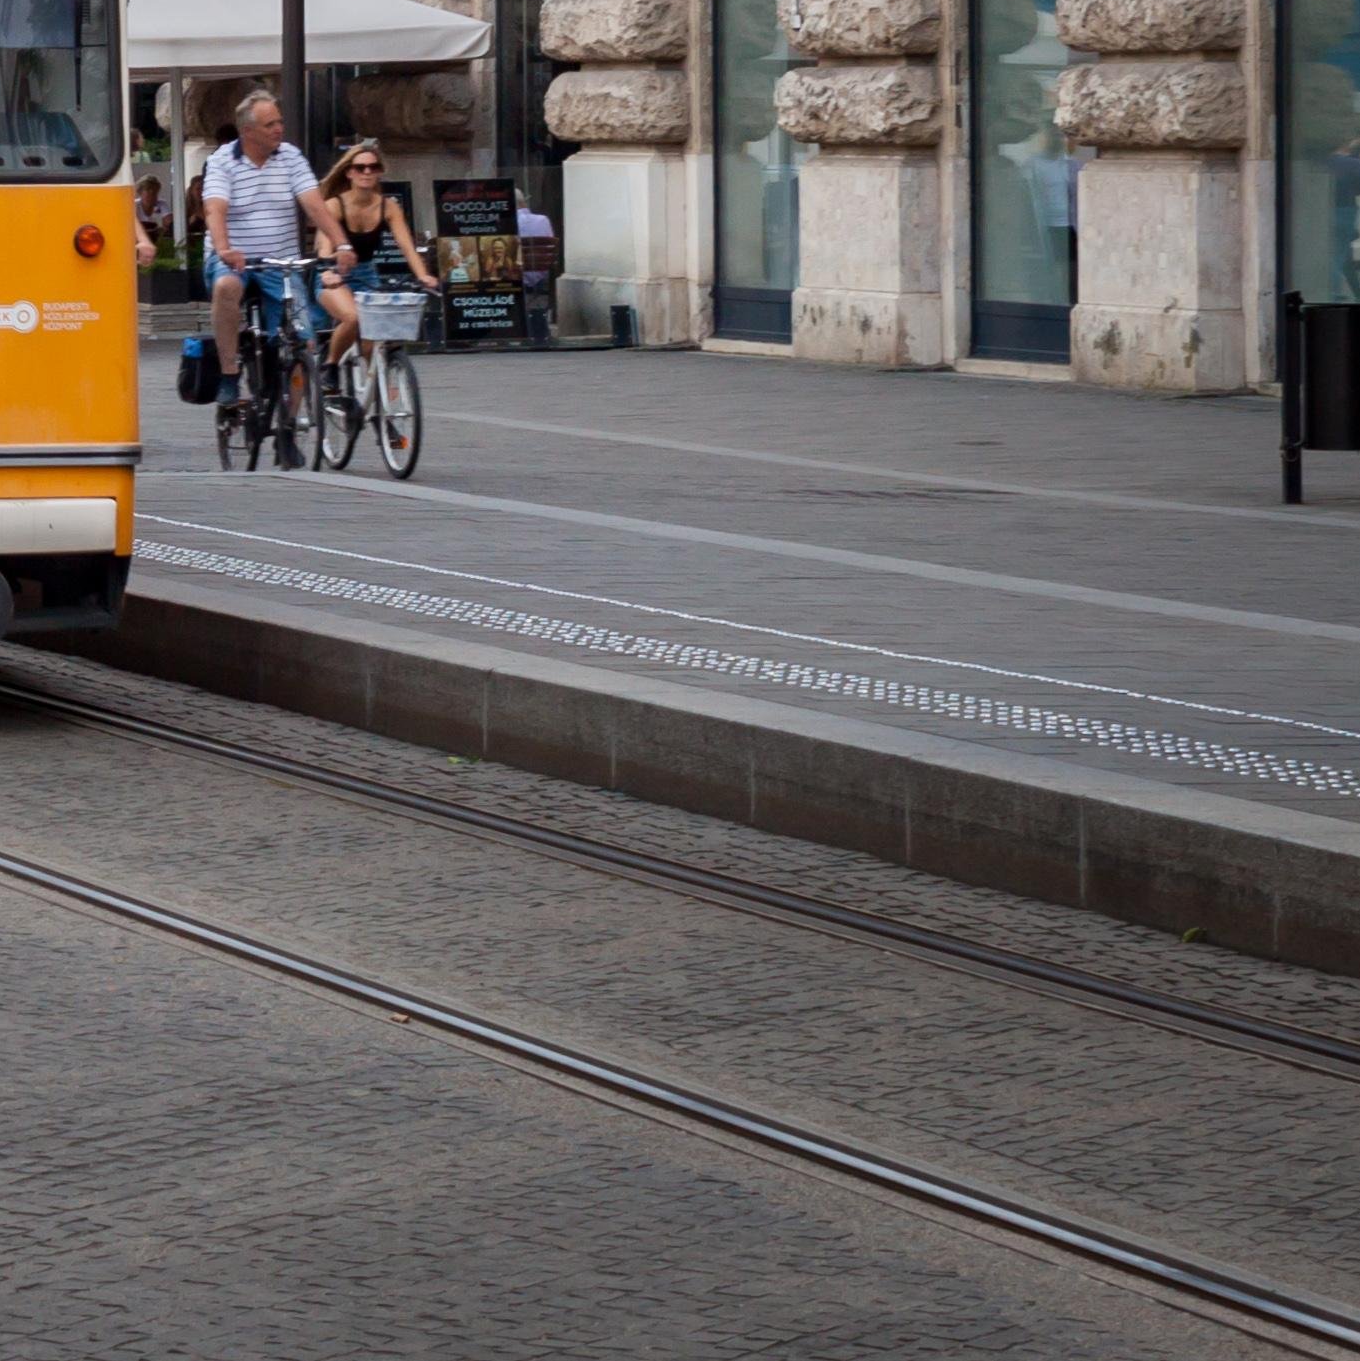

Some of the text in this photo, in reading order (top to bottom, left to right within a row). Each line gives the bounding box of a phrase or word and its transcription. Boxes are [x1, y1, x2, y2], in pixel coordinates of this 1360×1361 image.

[442, 200, 509, 213] CHOCOLATE
[453, 213, 500, 224] MUSEUM
[452, 294, 515, 307] CSOKOLÁDÉ
[462, 307, 508, 318] MÚZEUM
